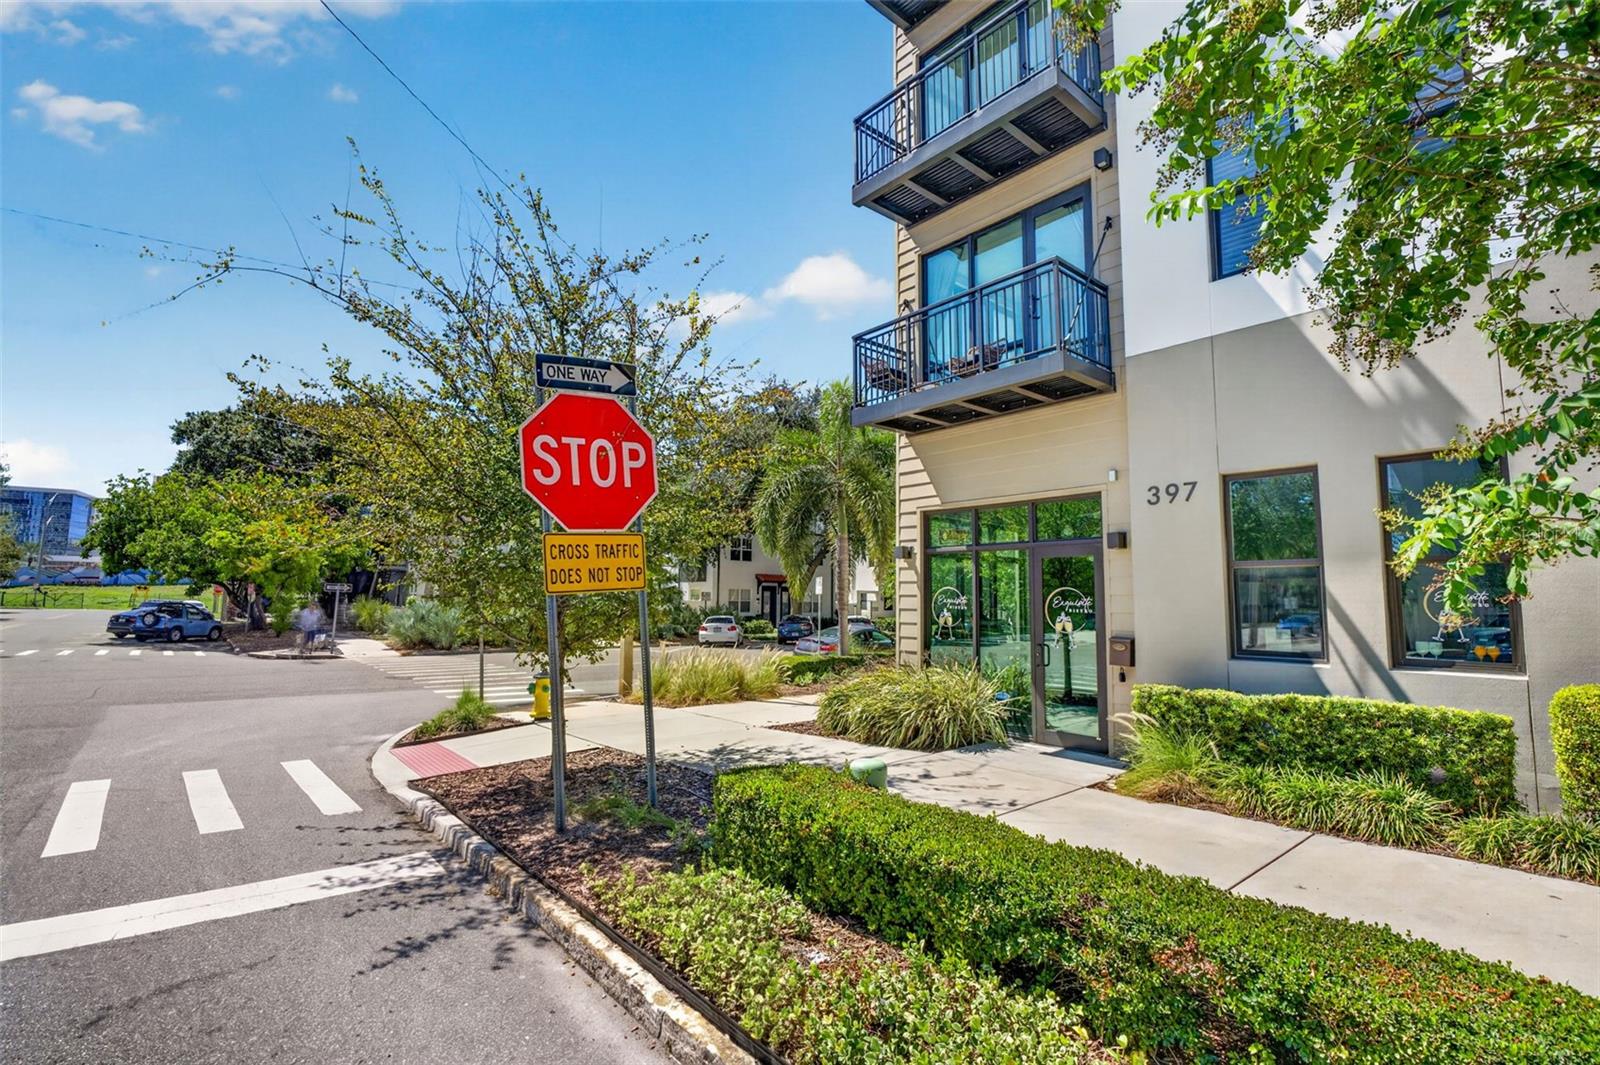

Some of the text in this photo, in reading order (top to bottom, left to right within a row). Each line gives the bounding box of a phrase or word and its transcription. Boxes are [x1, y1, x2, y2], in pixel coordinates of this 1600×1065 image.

[546, 365, 607, 383] ONE WAY
[532, 434, 647, 488] STOP
[1147, 481, 1198, 505] 397
[550, 543, 639, 560] CROSS TRAFFIC
[550, 566, 643, 584] DOES NOT STOP
[1053, 596, 1093, 611] Exquisite
